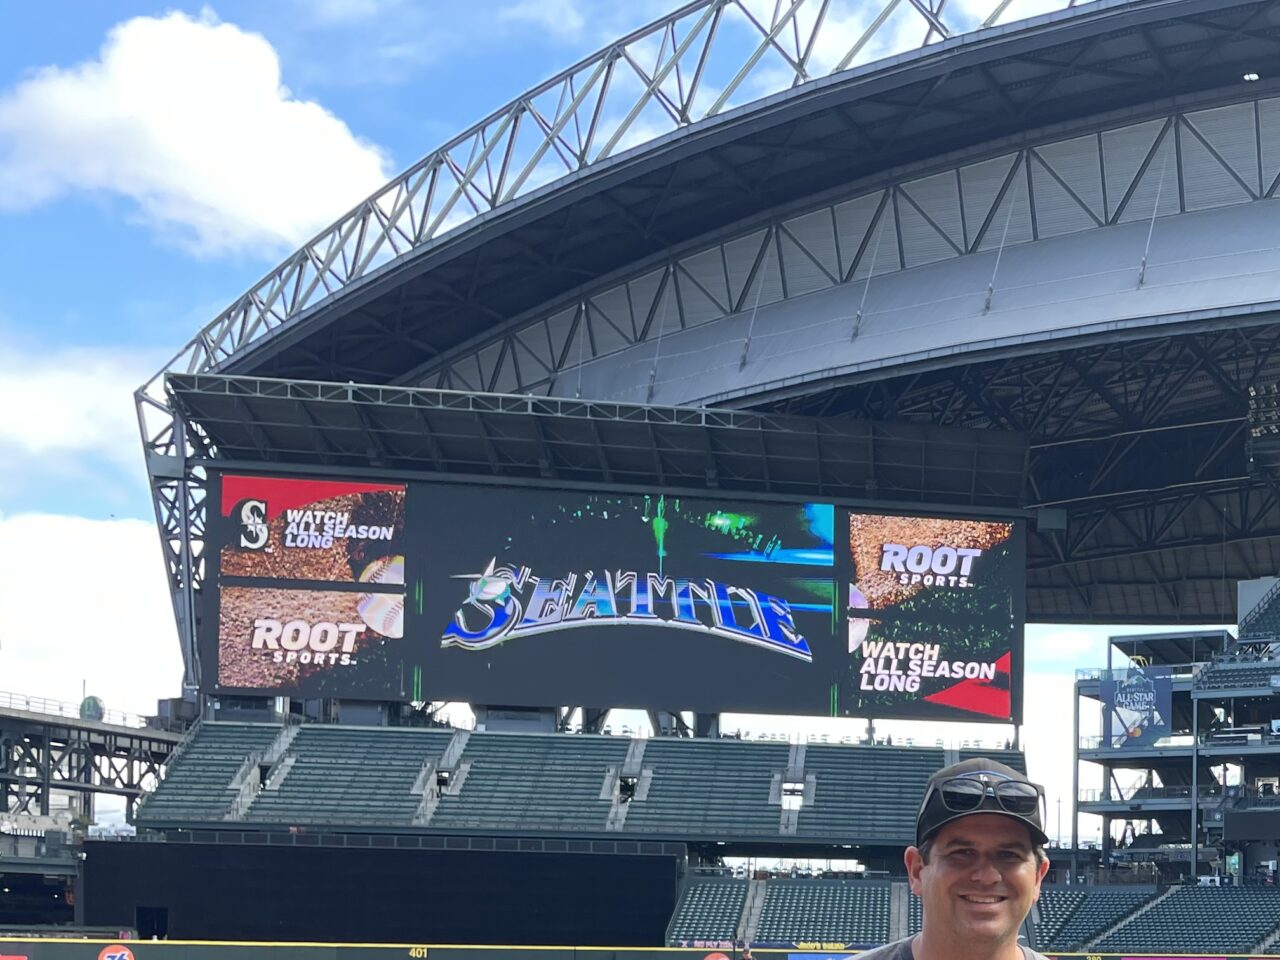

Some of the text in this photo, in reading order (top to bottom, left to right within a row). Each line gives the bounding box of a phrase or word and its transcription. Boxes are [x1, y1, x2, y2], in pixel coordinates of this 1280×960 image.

[285, 509, 349, 526] WATCH
[285, 521, 393, 541] ALL SEASON
[285, 533, 333, 550] LONG
[880, 544, 982, 576] ROOT
[899, 573, 968, 588] SPORTS
[251, 618, 366, 654] ROOT
[273, 649, 351, 665] SPORTS
[861, 641, 940, 661] WATCH
[860, 657, 996, 681] ALL SEASON
[860, 673, 921, 693] LONG
[409, 947, 427, 958] 401
